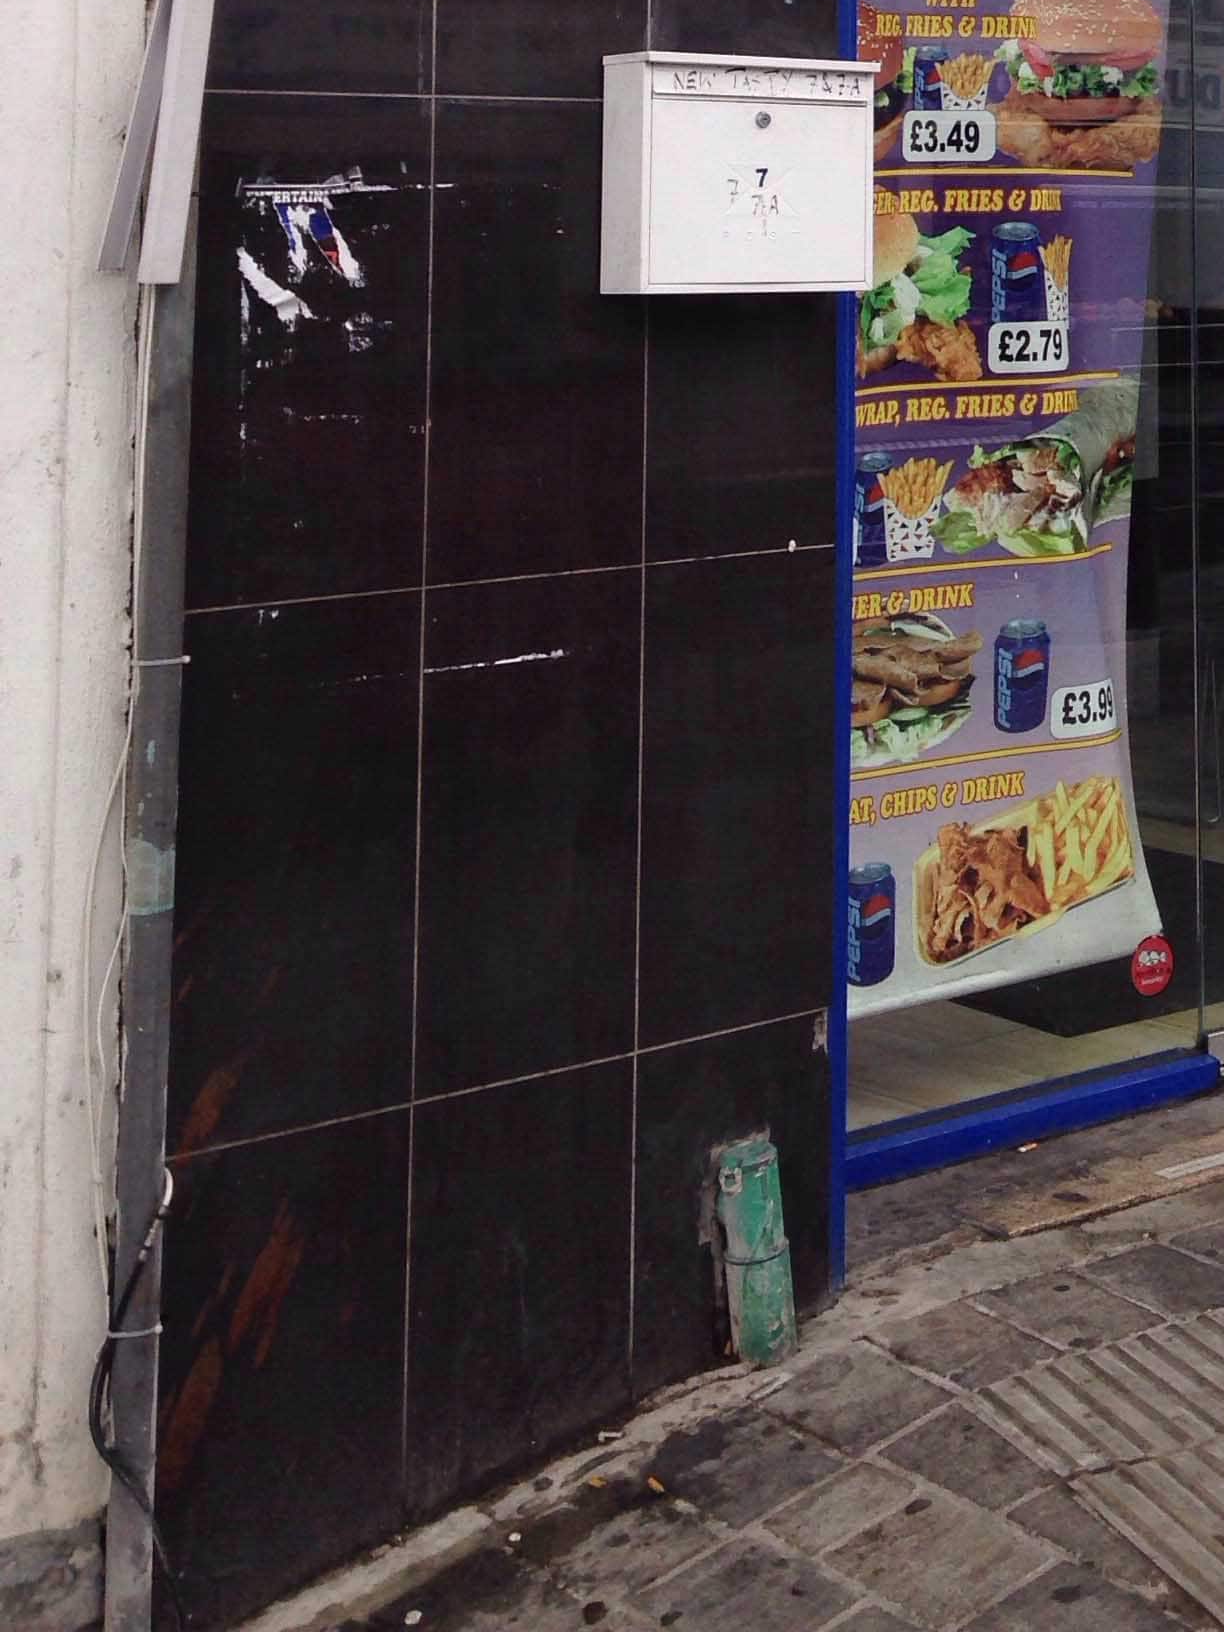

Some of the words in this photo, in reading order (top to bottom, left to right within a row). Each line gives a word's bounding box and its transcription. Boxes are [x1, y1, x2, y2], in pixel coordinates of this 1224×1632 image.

[906, 14, 953, 38] FRIES
[959, 17, 975, 38] &
[980, 15, 1040, 39] DRINK
[910, 120, 980, 153] £3.49
[755, 168, 768, 187] 7
[900, 189, 939, 213] REG.
[943, 189, 1003, 213] FRIES
[1008, 190, 1026, 212] &
[998, 329, 1062, 362] £2.79
[906, 397, 950, 422] REG.
[955, 394, 1016, 419] FRIES
[1019, 395, 1038, 415] &
[886, 591, 904, 615] &
[909, 583, 974, 613] DRINK
[996, 646, 1014, 729] PEPSI
[1061, 685, 1115, 726] £3.99
[880, 785, 938, 819] CHIPS
[940, 782, 957, 808] &
[961, 770, 1025, 805] DRINK
